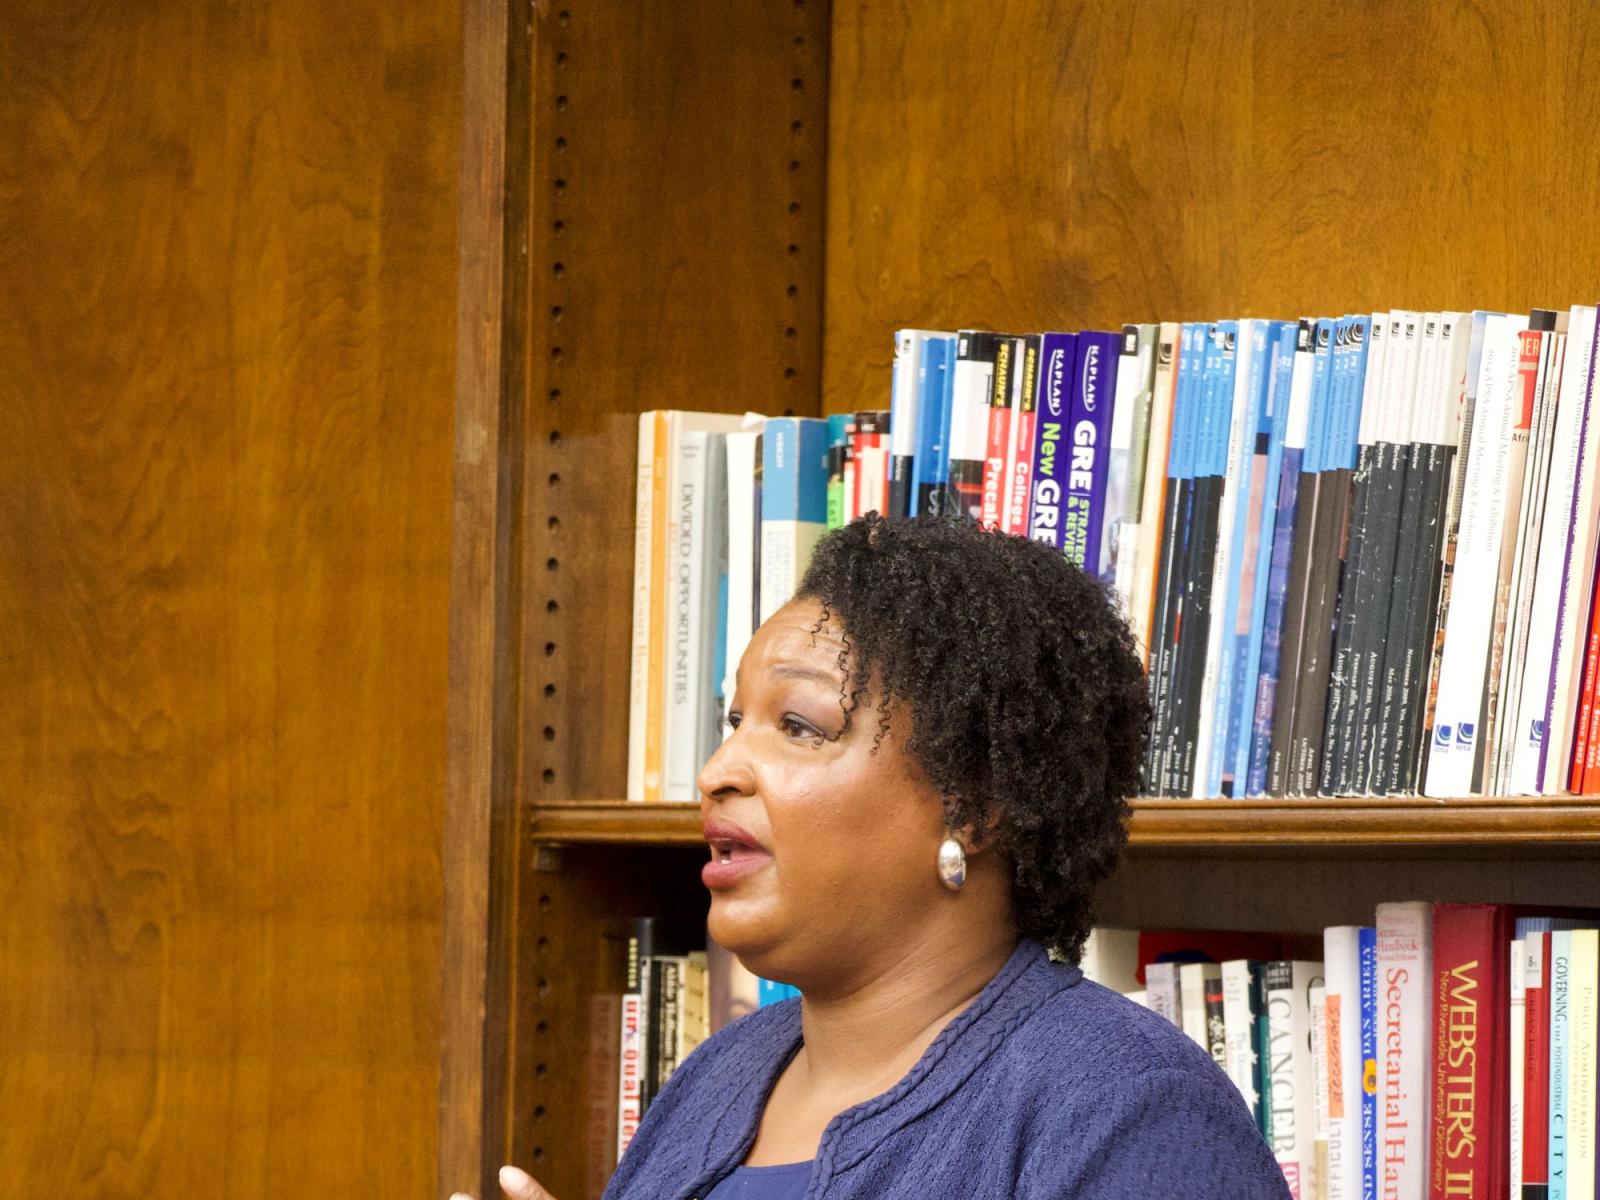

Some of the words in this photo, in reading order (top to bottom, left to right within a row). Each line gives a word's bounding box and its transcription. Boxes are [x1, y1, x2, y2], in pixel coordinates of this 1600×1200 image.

[996, 343, 1009, 406] SCHAUM'S
[1023, 348, 1036, 412] SCHAUM'S
[1051, 349, 1065, 408] KAPLAN
[1086, 345, 1100, 405] KAPLAN
[1481, 375, 1493, 403] APSA
[1503, 372, 1518, 402] APSA
[1577, 366, 1589, 395] APSA
[1476, 408, 1489, 442] Annual
[1499, 406, 1512, 441] Annual
[1573, 398, 1584, 436] Annual
[1039, 423, 1062, 476] New
[1069, 420, 1097, 491] GRE
[1359, 445, 1368, 471] Review
[1377, 443, 1386, 469] Review
[1392, 444, 1400, 471] Review
[1412, 443, 1421, 470] Review
[1429, 445, 1437, 471] Review
[1470, 446, 1485, 490] Meeting
[1491, 443, 1508, 487] Meeting
[1565, 439, 1579, 481] Meeting
[680, 483, 694, 557] DIVIDED
[1010, 461, 1029, 526] College
[1032, 479, 1061, 547] GRE
[1068, 496, 1079, 509] &
[1463, 501, 1478, 555] Exhibition
[1485, 499, 1500, 553] Exhibition
[1559, 494, 1573, 548] Exhibition
[675, 564, 691, 705] OPPORTUNITIES
[1367, 652, 1378, 685] AUGUST
[1362, 945, 1372, 1012] ARIELY
[1439, 970, 1450, 1001] New
[1555, 957, 1569, 1021] GOVERNING
[1362, 1018, 1372, 1054] DAN
[1384, 967, 1409, 1131] Secretarial
[1437, 1003, 1449, 1060] Riverside
[1554, 1025, 1562, 1041] THE
[1268, 997, 1297, 1154] CANCER
[1445, 960, 1478, 1159] WEBSTER'S
[1553, 1046, 1564, 1110] POSTINDUSTRIAL
[1433, 1062, 1448, 1125] University
[1579, 1040, 1591, 1160] ADMINISTRATION
[1361, 1103, 1374, 1168] SENSE
[1433, 1126, 1447, 1191] Dictionary
[1444, 1169, 1474, 1199] II
